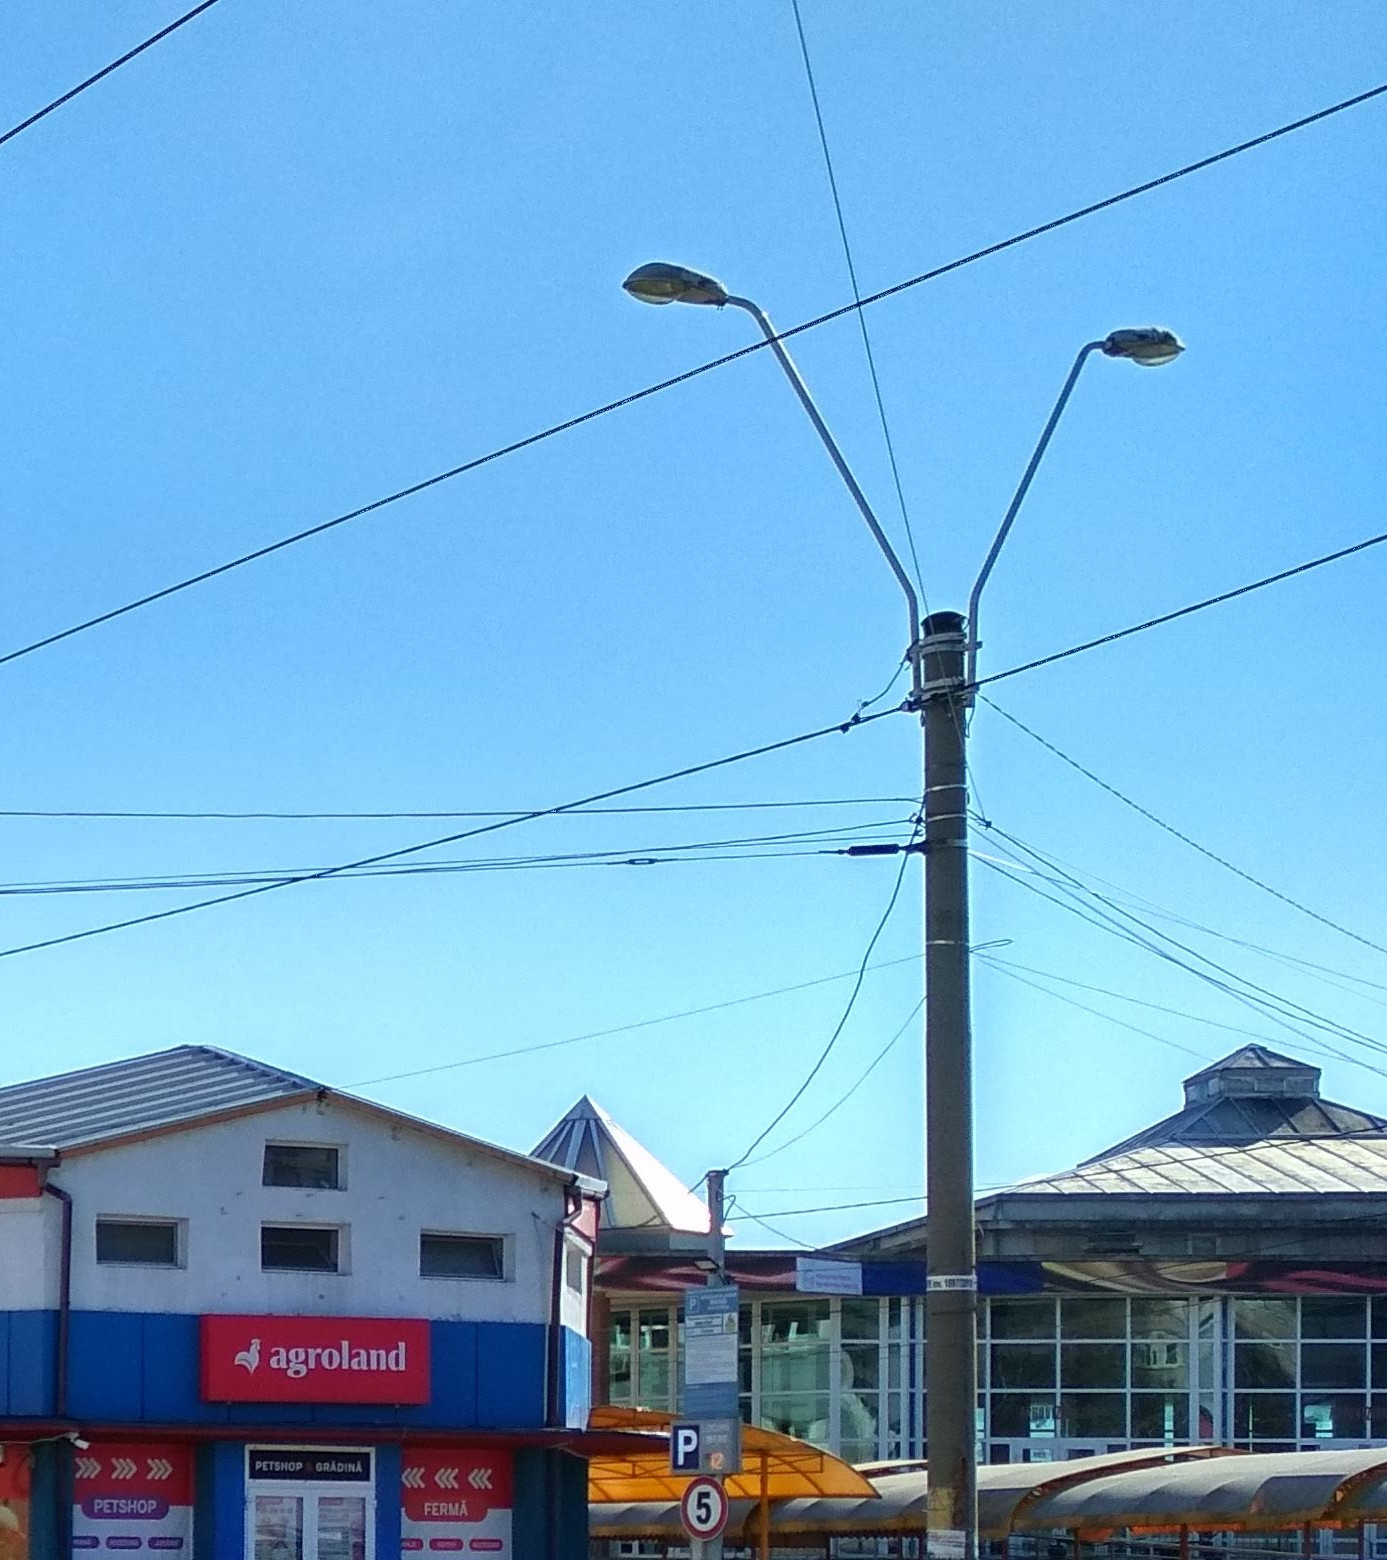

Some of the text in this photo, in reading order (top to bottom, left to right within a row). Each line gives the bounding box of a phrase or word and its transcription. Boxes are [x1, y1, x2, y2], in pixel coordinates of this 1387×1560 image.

[269, 1340, 406, 1379] agroland
[677, 1429, 698, 1466] P
[255, 1460, 362, 1473] PETSHOP GRĂDINĂ
[94, 1499, 157, 1514] PETSHOP
[424, 1500, 468, 1516] FERMĂ
[696, 1492, 712, 1524] 5
